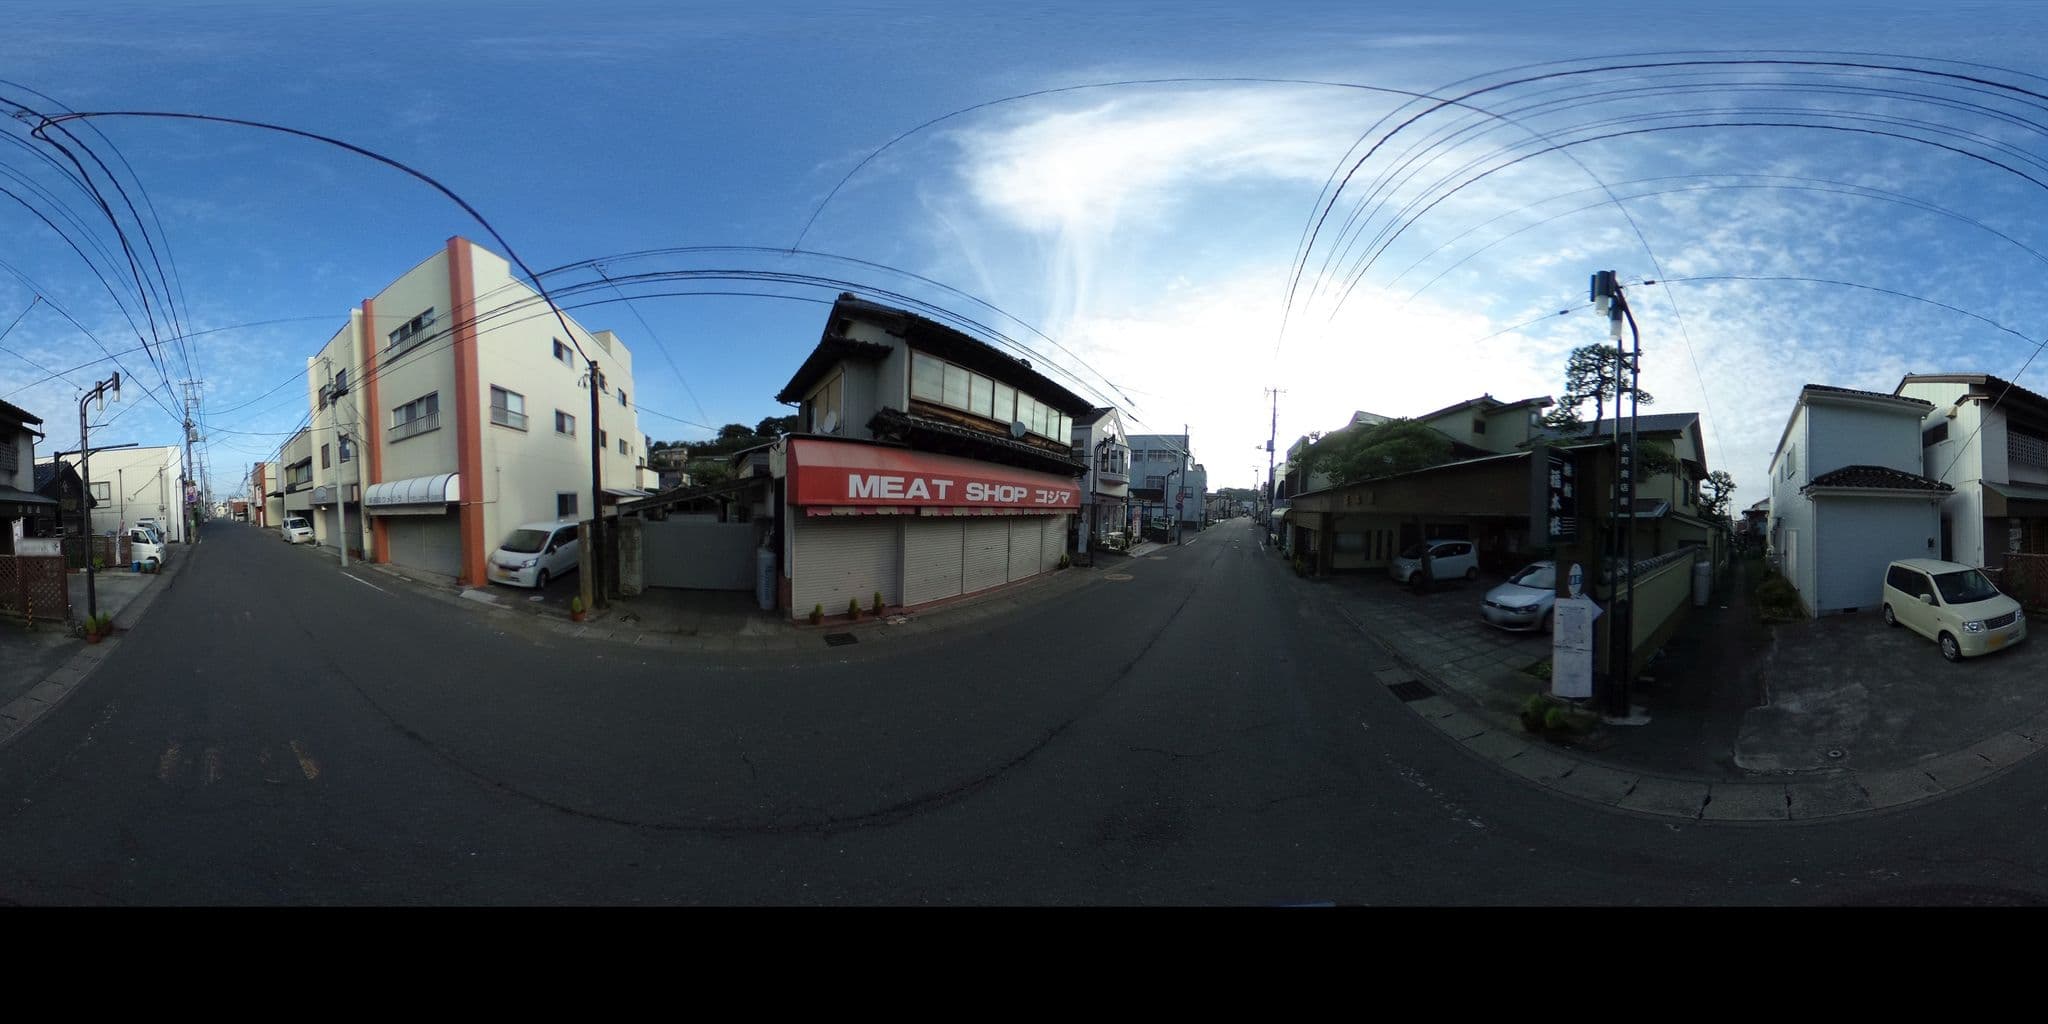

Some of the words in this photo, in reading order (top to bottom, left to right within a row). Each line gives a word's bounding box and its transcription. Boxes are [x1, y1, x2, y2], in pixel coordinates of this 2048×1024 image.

[848, 474, 954, 500] MEAT
[966, 482, 1028, 503] SHOP
[1035, 489, 1071, 505] コジマ
